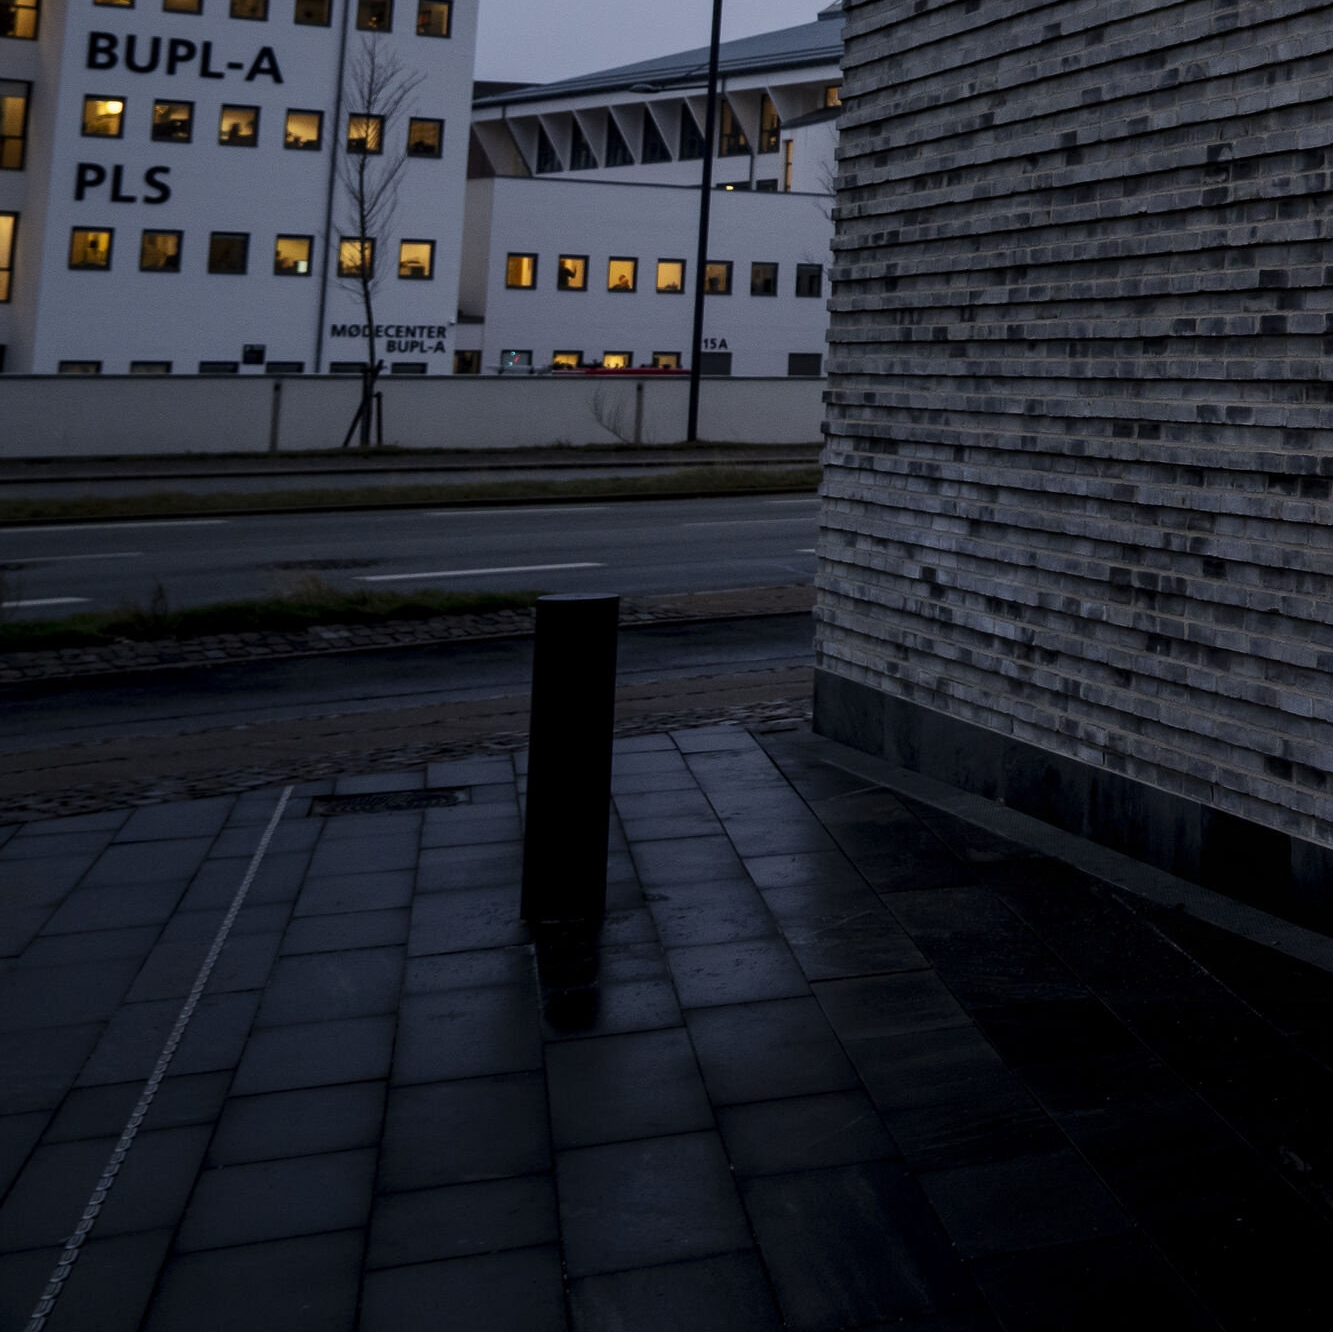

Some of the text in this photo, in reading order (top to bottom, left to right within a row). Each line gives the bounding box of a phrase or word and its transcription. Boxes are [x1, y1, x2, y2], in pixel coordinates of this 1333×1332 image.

[86, 31, 284, 84] BUPL-A
[74, 163, 172, 204] PLS
[330, 324, 447, 339] MØDECENTER
[386, 340, 446, 353] BUPL-A
